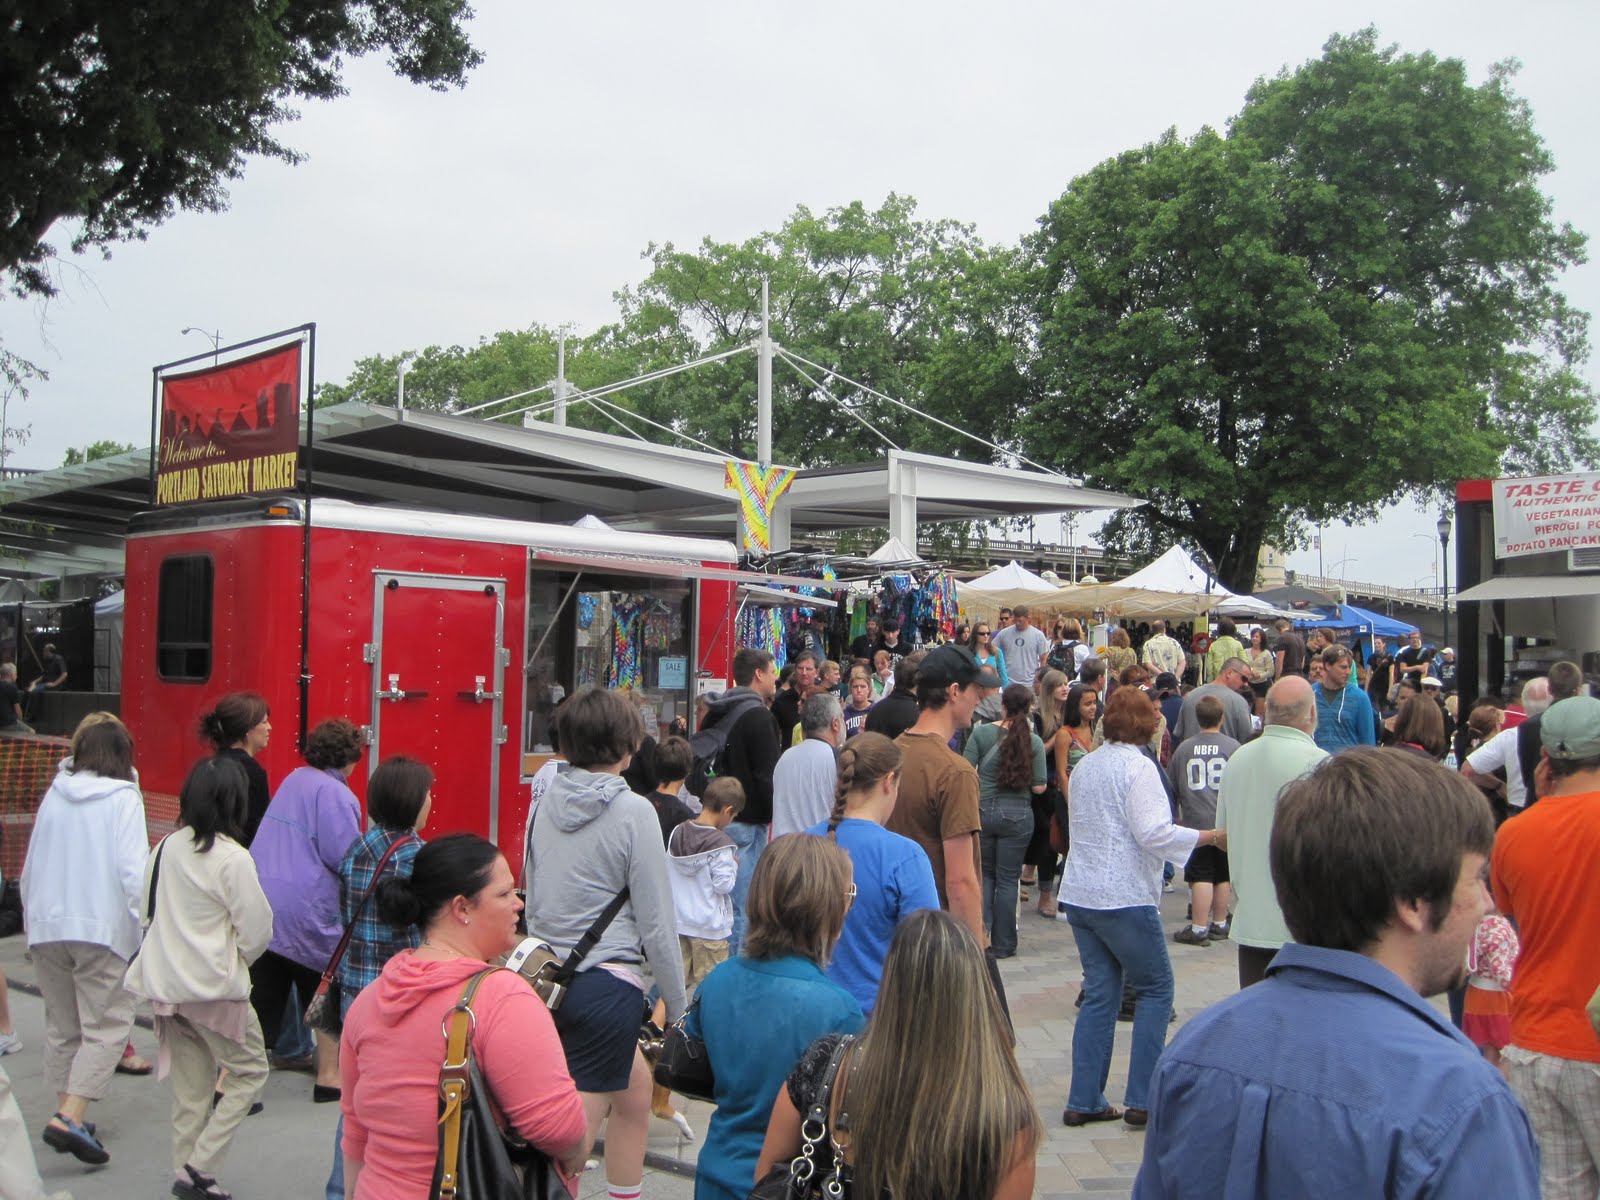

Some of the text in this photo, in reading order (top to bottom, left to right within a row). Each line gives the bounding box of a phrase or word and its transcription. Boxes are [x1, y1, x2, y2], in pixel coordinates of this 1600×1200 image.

[160, 430, 205, 466] Welcome
[157, 452, 297, 505] PORTLAND SATURDAY MARKET
[1505, 480, 1585, 498] TASTE
[1512, 493, 1598, 508] AUTHENTIC
[1535, 521, 1580, 535] PIEROGI
[1506, 540, 1545, 553] POTATO
[665, 662, 681, 671] SALE
[1193, 744, 1219, 756] NBFD
[1186, 757, 1228, 791] 08
